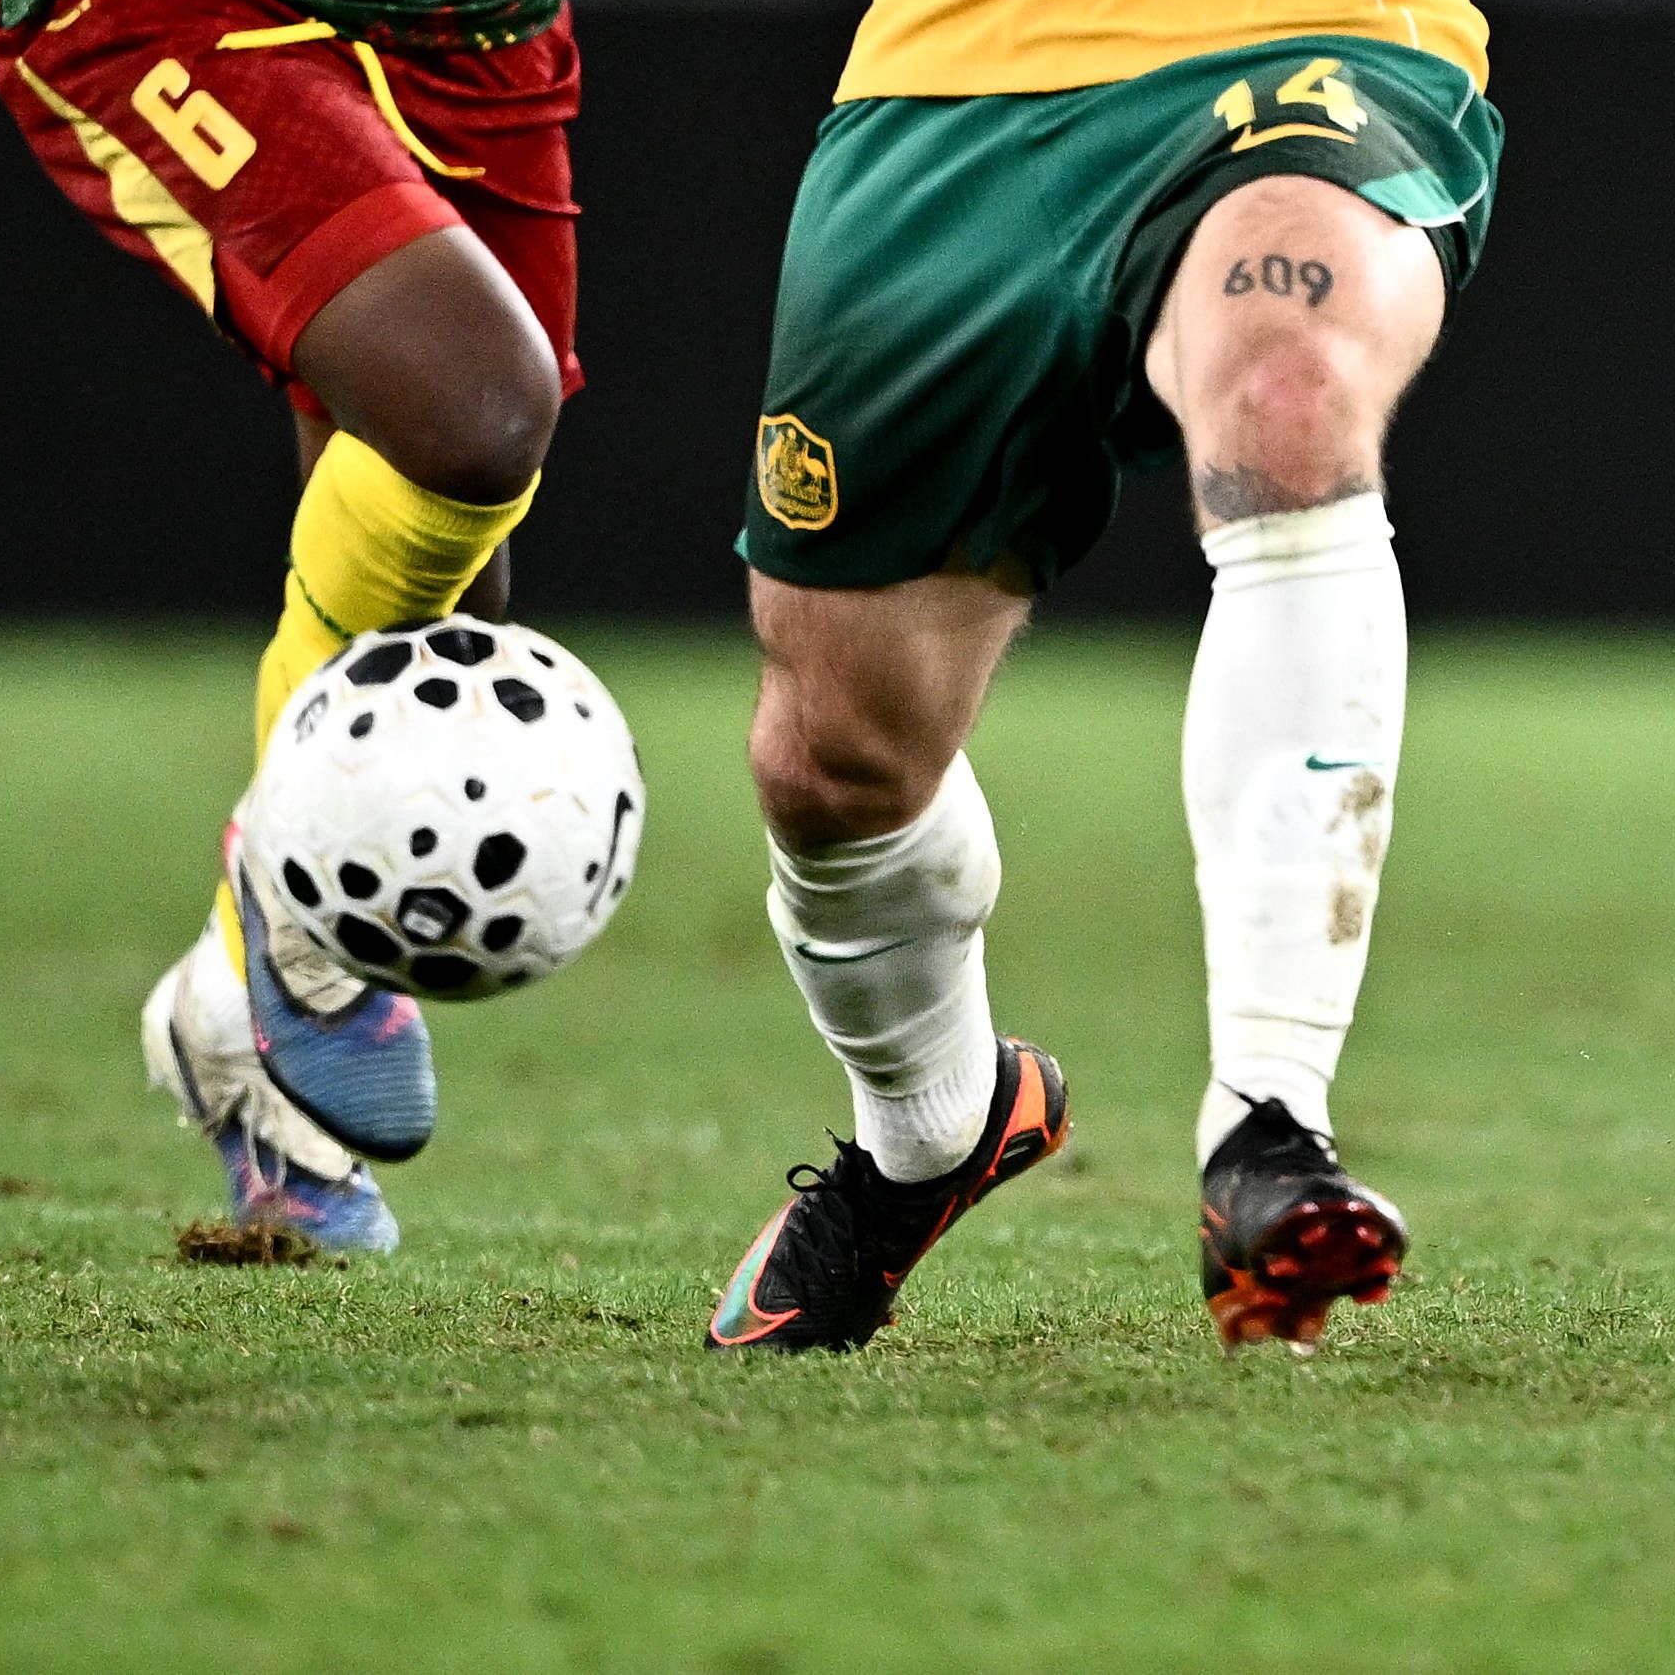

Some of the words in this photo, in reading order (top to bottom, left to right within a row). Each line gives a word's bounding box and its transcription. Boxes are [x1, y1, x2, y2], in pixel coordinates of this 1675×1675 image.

[131, 58, 257, 191] 6
[1214, 57, 1368, 132] 14
[1224, 253, 1334, 308] 609
